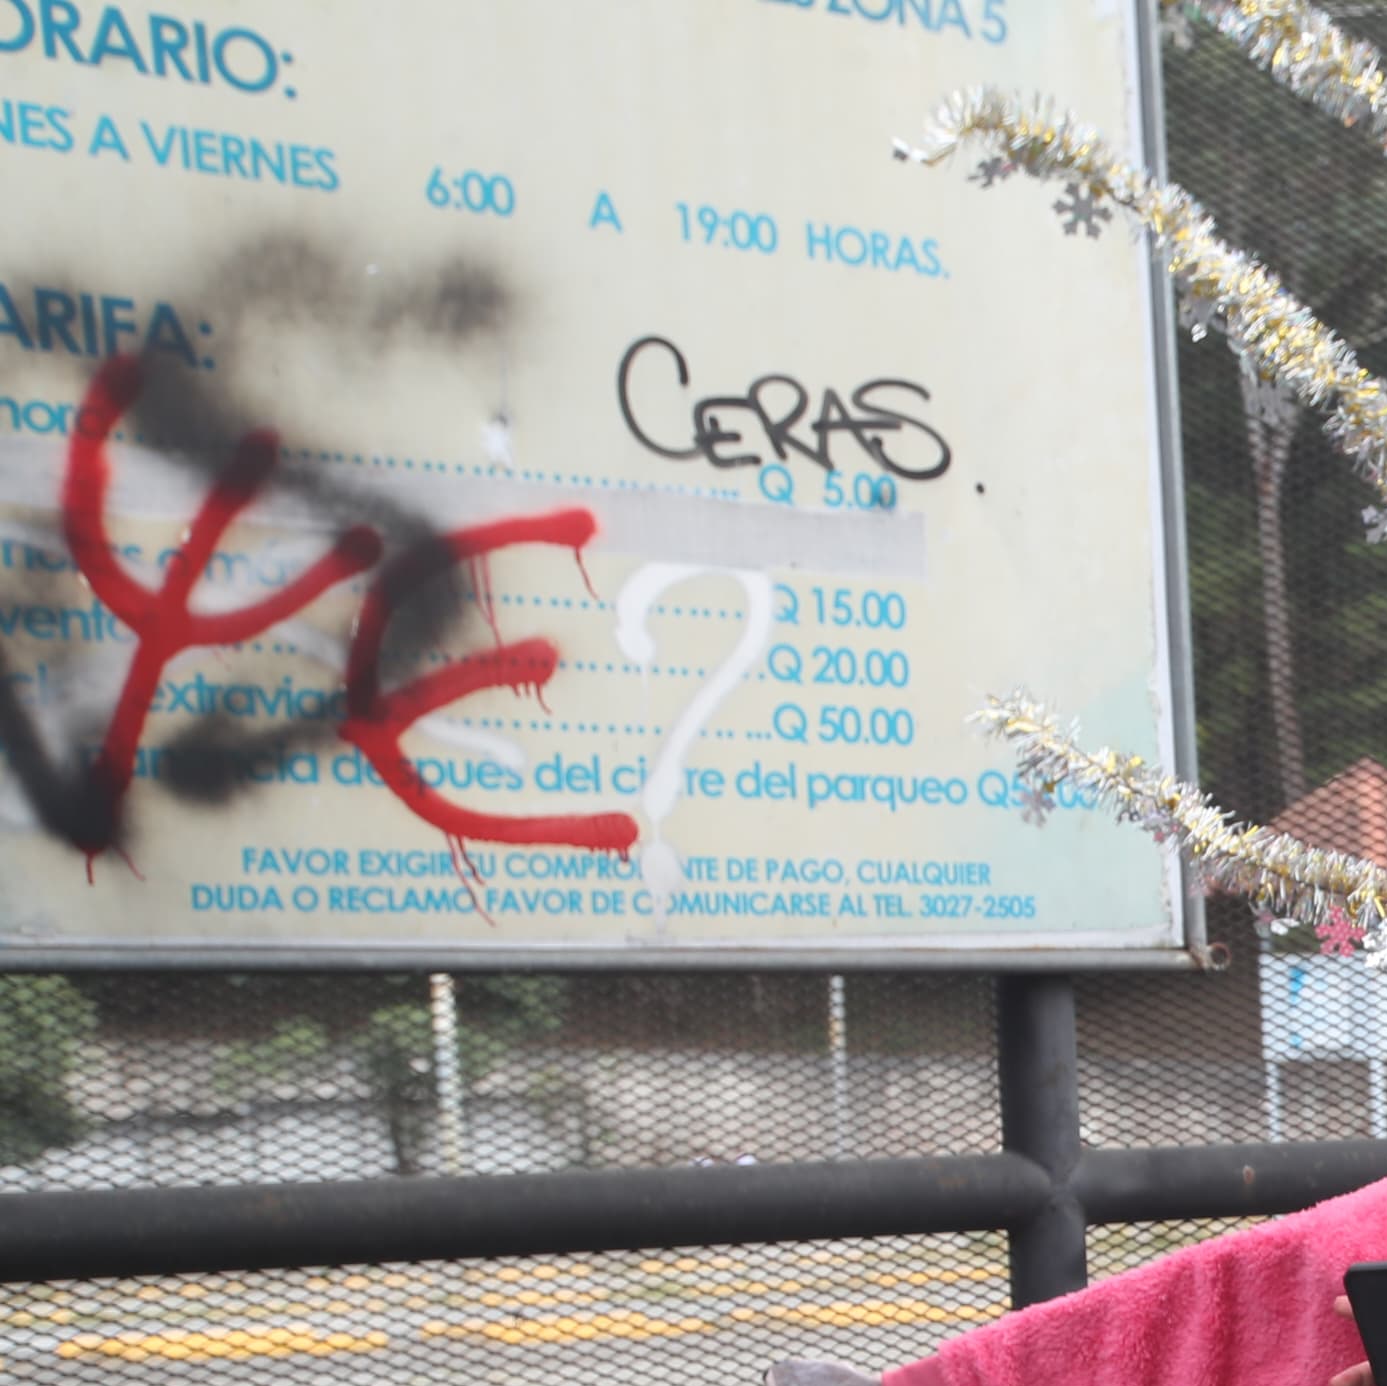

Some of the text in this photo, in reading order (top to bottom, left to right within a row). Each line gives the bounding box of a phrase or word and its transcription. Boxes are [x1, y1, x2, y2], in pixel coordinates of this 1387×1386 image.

[87, 113, 130, 162] A
[138, 119, 342, 192] VIERNES
[425, 165, 517, 217] 6:00
[588, 191, 624, 233] A
[675, 201, 779, 255] 19:00
[804, 219, 951, 280] HORAS.
[758, 464, 794, 505] Q
[823, 470, 897, 510] 5.00
[810, 586, 906, 630] 15.00
[768, 643, 803, 685] Q
[811, 645, 910, 687] 20.00
[772, 702, 808, 743] Q
[817, 704, 914, 746] 50.00
[534, 752, 602, 796] del
[611, 757, 725, 799] cire
[736, 761, 796, 799] del
[806, 770, 968, 812] parqueo
[242, 848, 349, 877] FAVOR
[358, 850, 456, 879] EXIGIR
[504, 852, 718, 884] COMPROTE
[726, 858, 759, 884] DE
[765, 859, 850, 888] PAGO,
[856, 861, 992, 889] CUALQUIER
[191, 885, 284, 912] DUDA
[292, 886, 319, 913] O
[328, 887, 477, 915] RECLAMO
[484, 889, 584, 916] FAVOR
[592, 892, 628, 916] DE
[837, 893, 867, 918] AL
[919, 896, 1038, 921] 3027-2505
